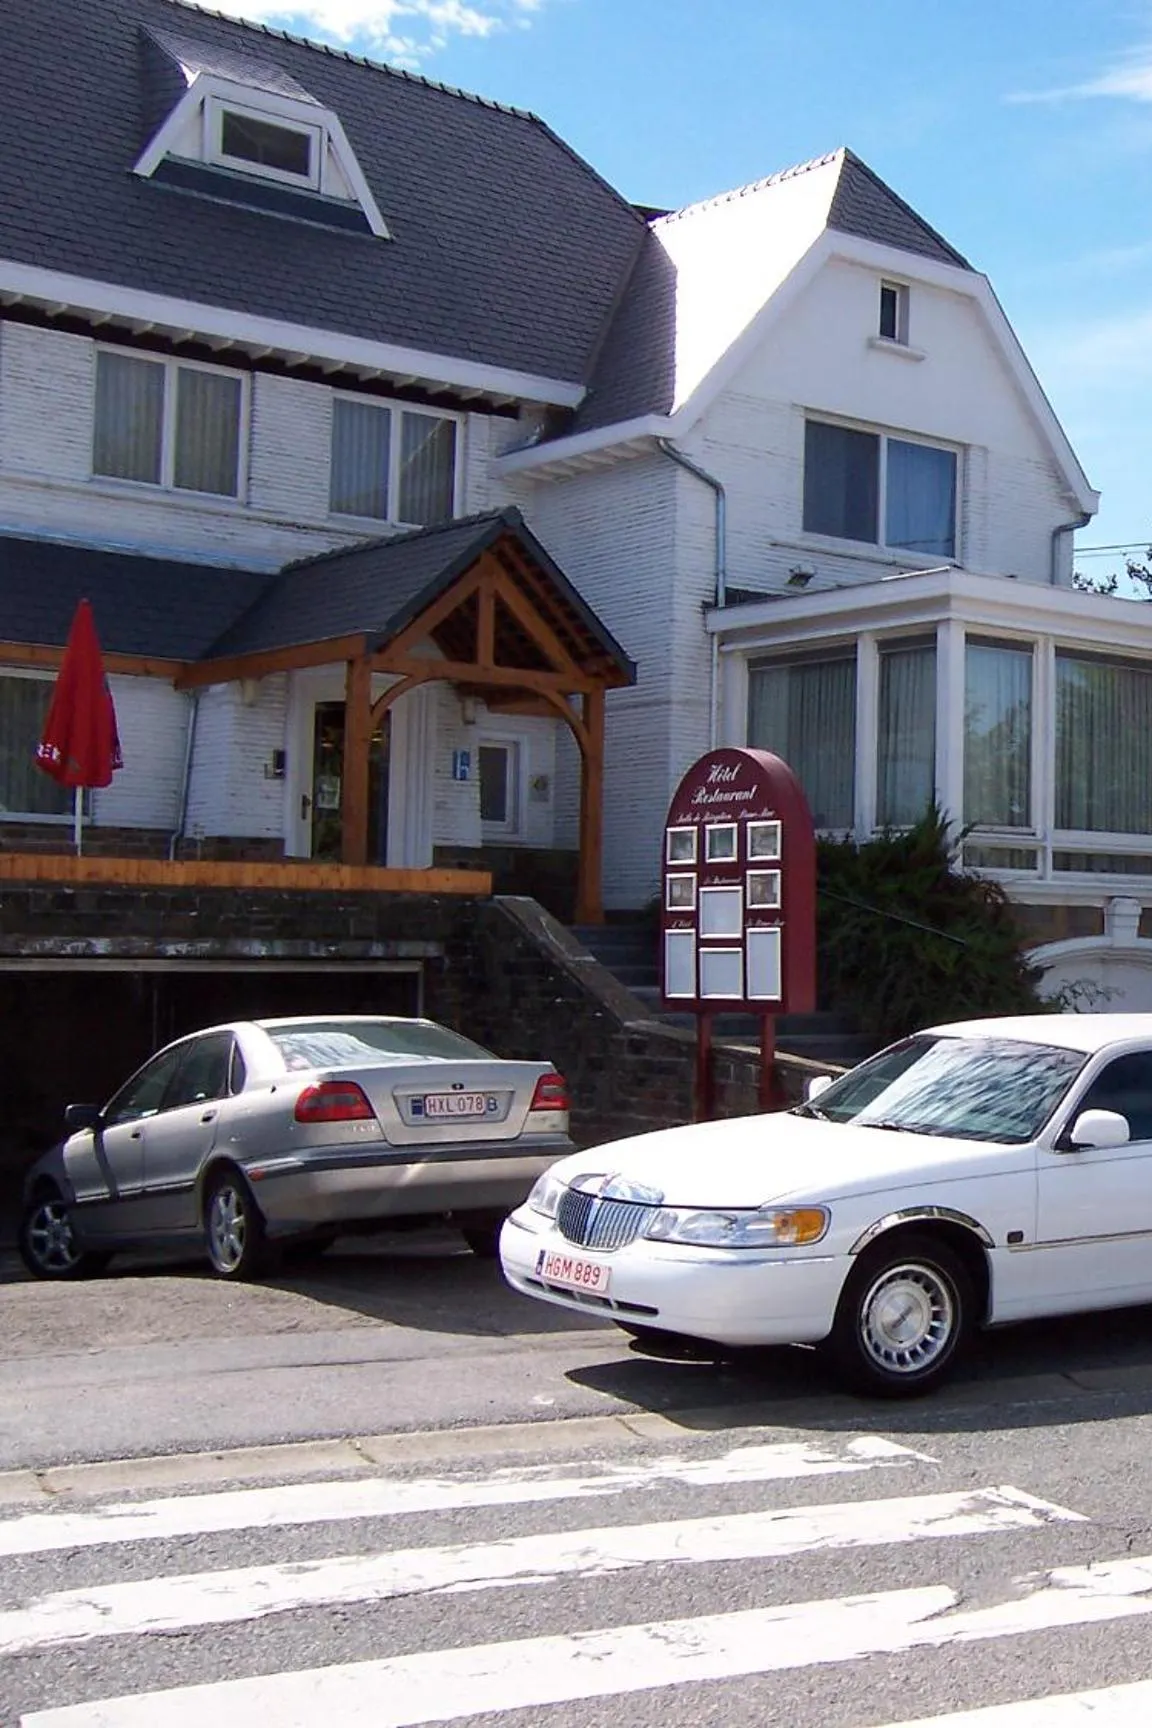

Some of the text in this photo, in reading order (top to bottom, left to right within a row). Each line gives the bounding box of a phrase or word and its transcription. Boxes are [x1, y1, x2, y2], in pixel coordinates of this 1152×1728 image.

[692, 785, 757, 804] Restaurant
[428, 1099, 454, 1113] HXL
[458, 1096, 484, 1112] 078
[545, 1256, 572, 1278] HGM
[574, 1262, 601, 1286] 889
